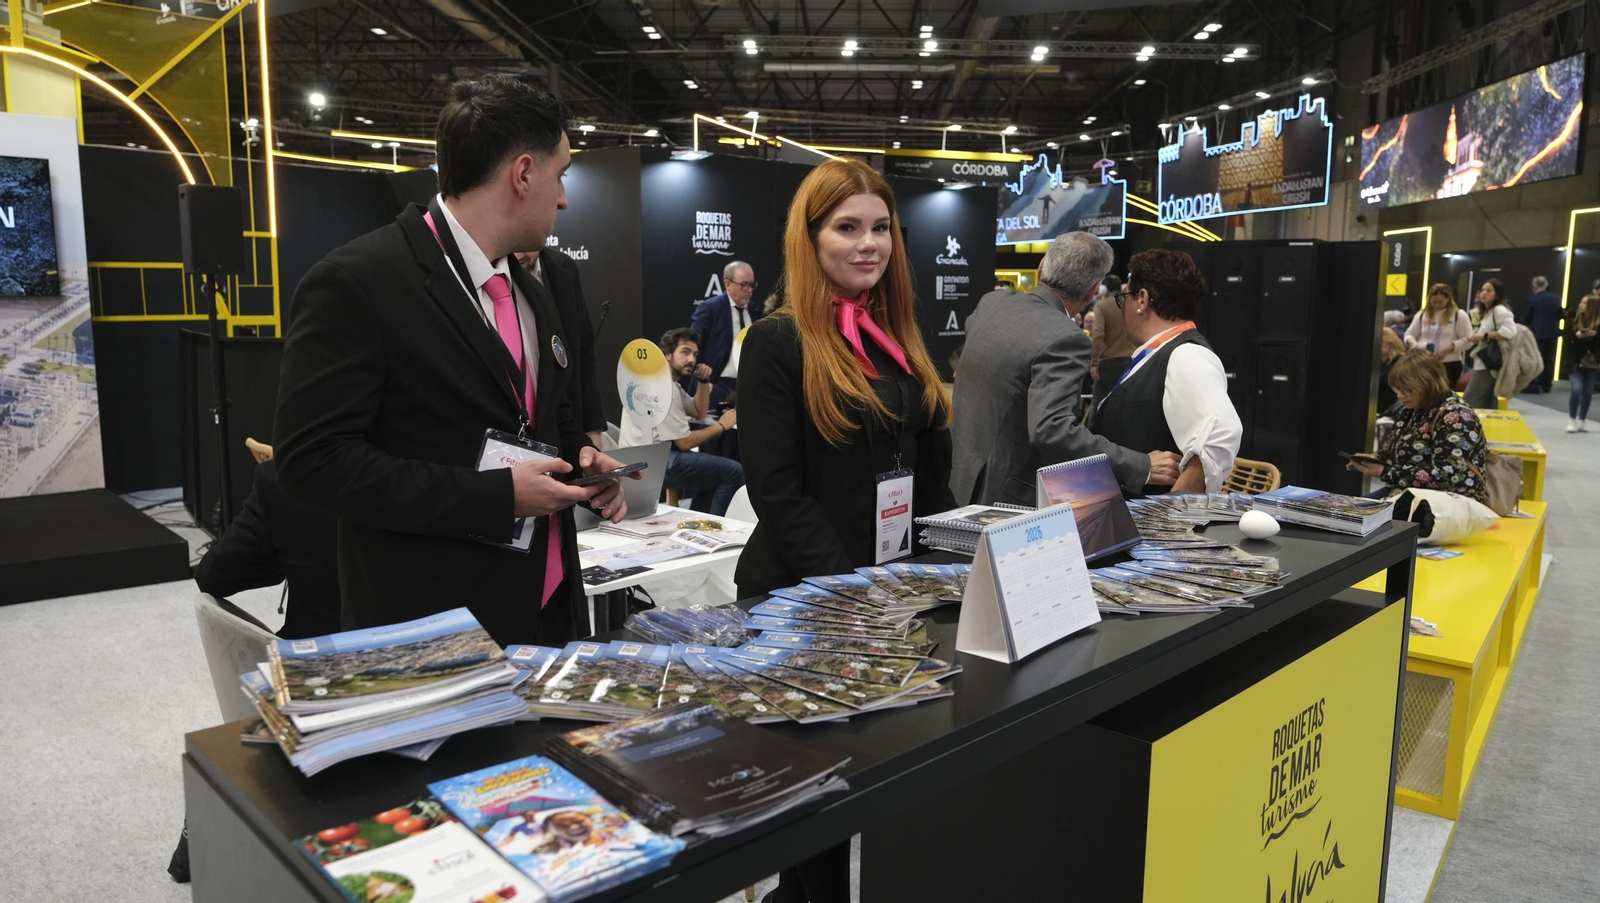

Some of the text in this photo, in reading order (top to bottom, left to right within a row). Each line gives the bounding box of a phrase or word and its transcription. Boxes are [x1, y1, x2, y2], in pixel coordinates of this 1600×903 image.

[952, 161, 1009, 177] CÓRDOBA
[1159, 192, 1223, 222] CÓRDOBA
[696, 211, 732, 225] ROQUETAS
[1005, 217, 1022, 231] DEL
[1023, 215, 1041, 229] SOL
[545, 234, 559, 247] nta
[696, 224, 732, 241] DE MAR
[692, 234, 731, 250] turismo
[560, 245, 589, 260] lucía
[636, 348, 648, 360] 03
[884, 506, 907, 517] EXPOSITOR
[1025, 525, 1043, 543] 2026
[1272, 697, 1326, 761] ROQUETAS
[1268, 732, 1323, 807] DE MAR
[1260, 779, 1318, 837] turismo
[1266, 818, 1346, 903] lucía
